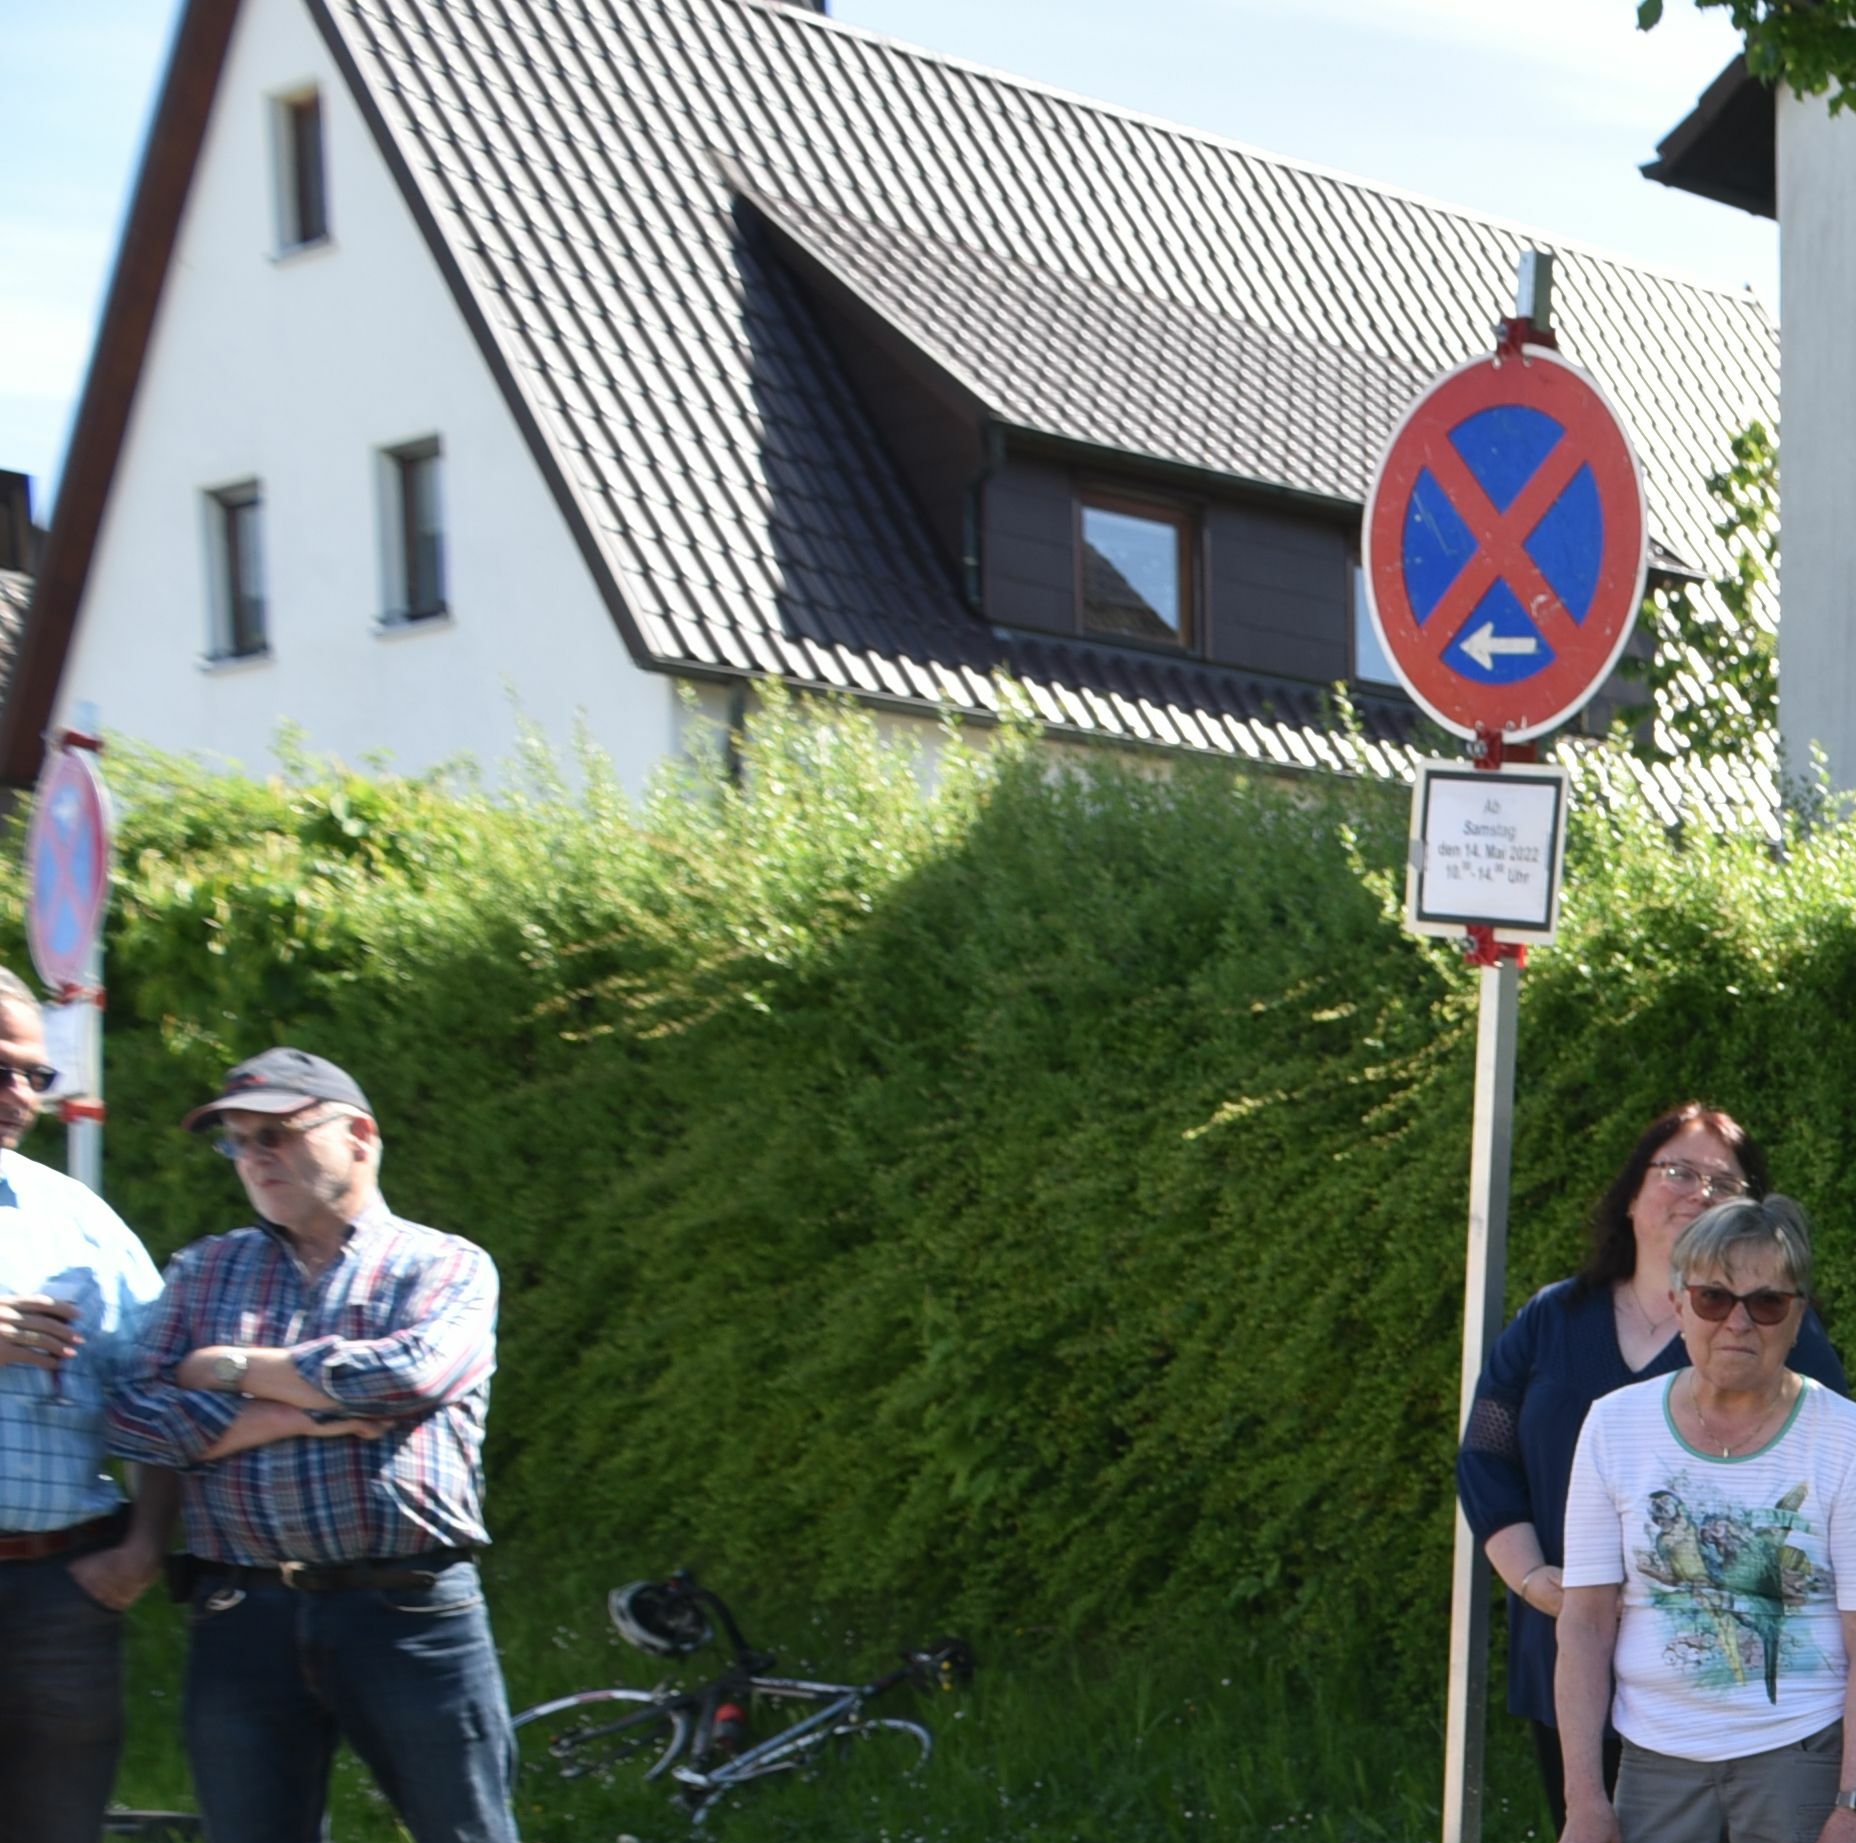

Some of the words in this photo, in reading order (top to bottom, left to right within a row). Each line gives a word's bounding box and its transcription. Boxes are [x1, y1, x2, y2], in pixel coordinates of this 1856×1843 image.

[1483, 797, 1501, 815] Ab
[1463, 819, 1517, 841] Samstag
[1437, 842, 1460, 858] den
[1485, 844, 1506, 860] Mai
[1509, 846, 1540, 863] 2022
[1507, 868, 1531, 884] Uhr
